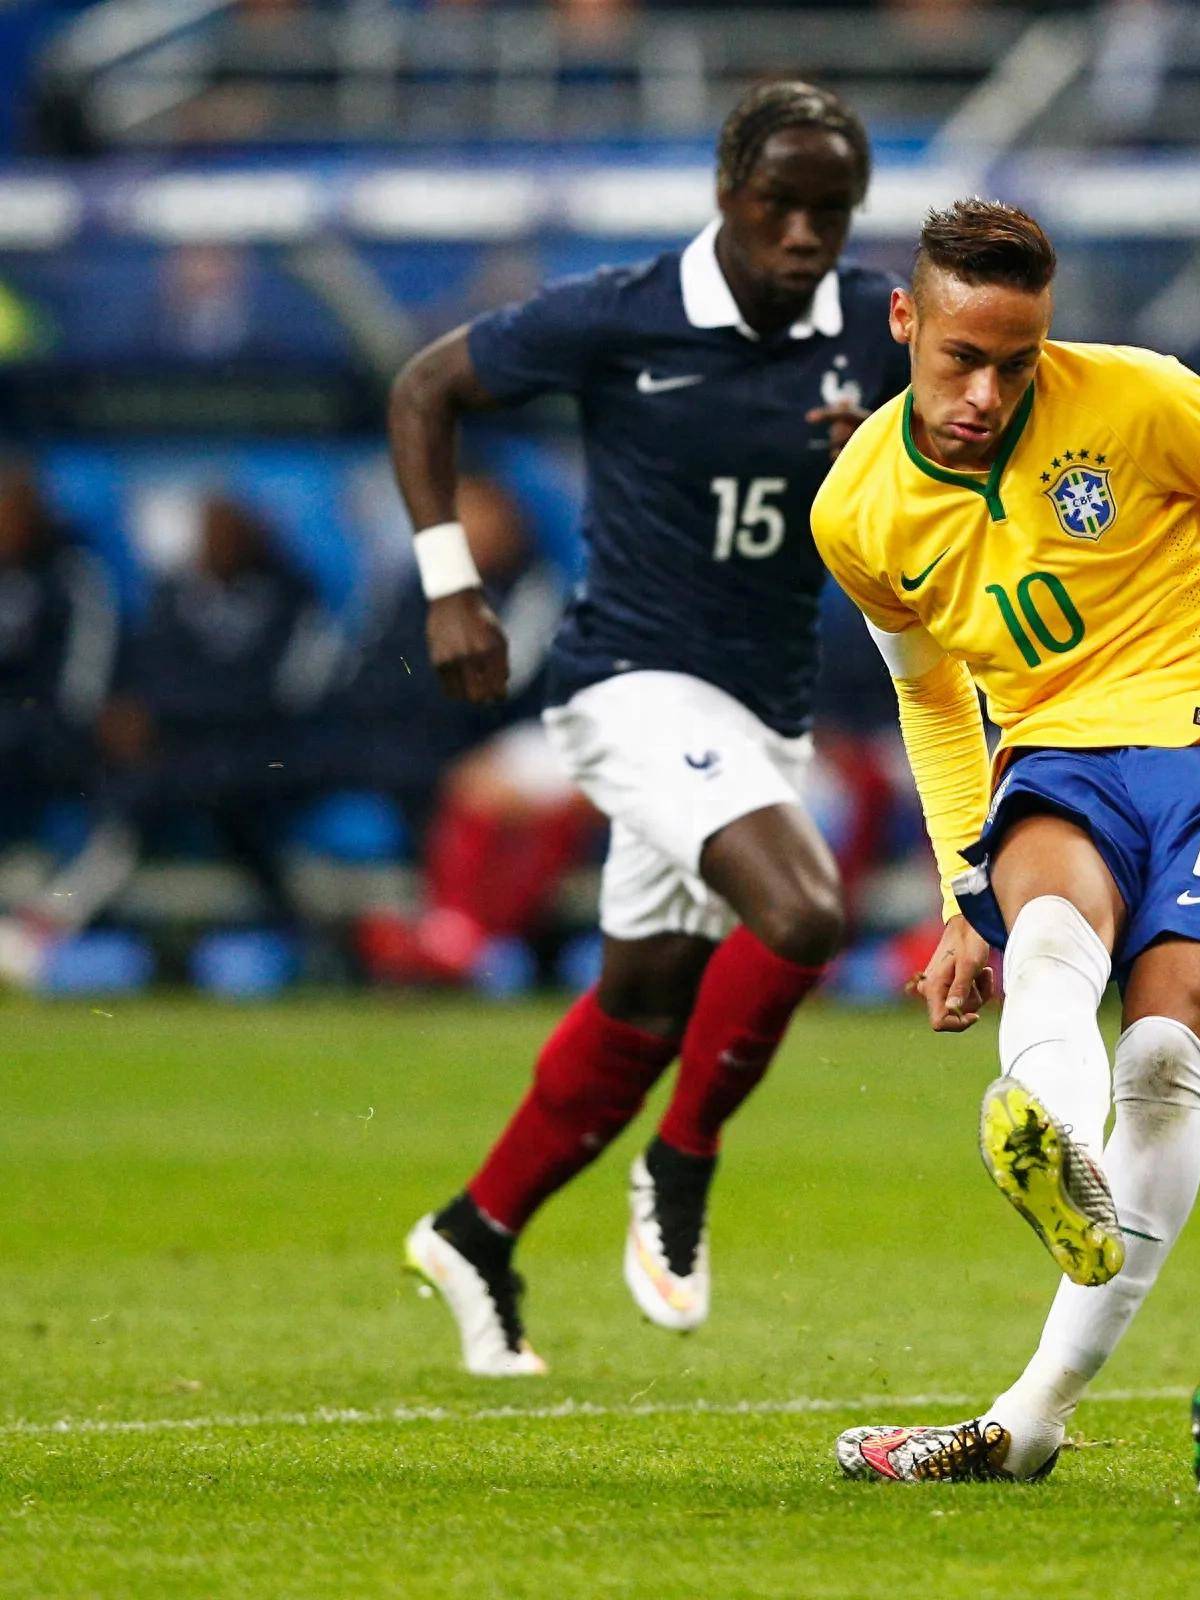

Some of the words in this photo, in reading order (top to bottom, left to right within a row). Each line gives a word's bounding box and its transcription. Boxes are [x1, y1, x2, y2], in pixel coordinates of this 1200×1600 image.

[709, 476, 788, 562] 15
[1072, 493, 1093, 508] CBF
[984, 571, 1086, 669] 10
